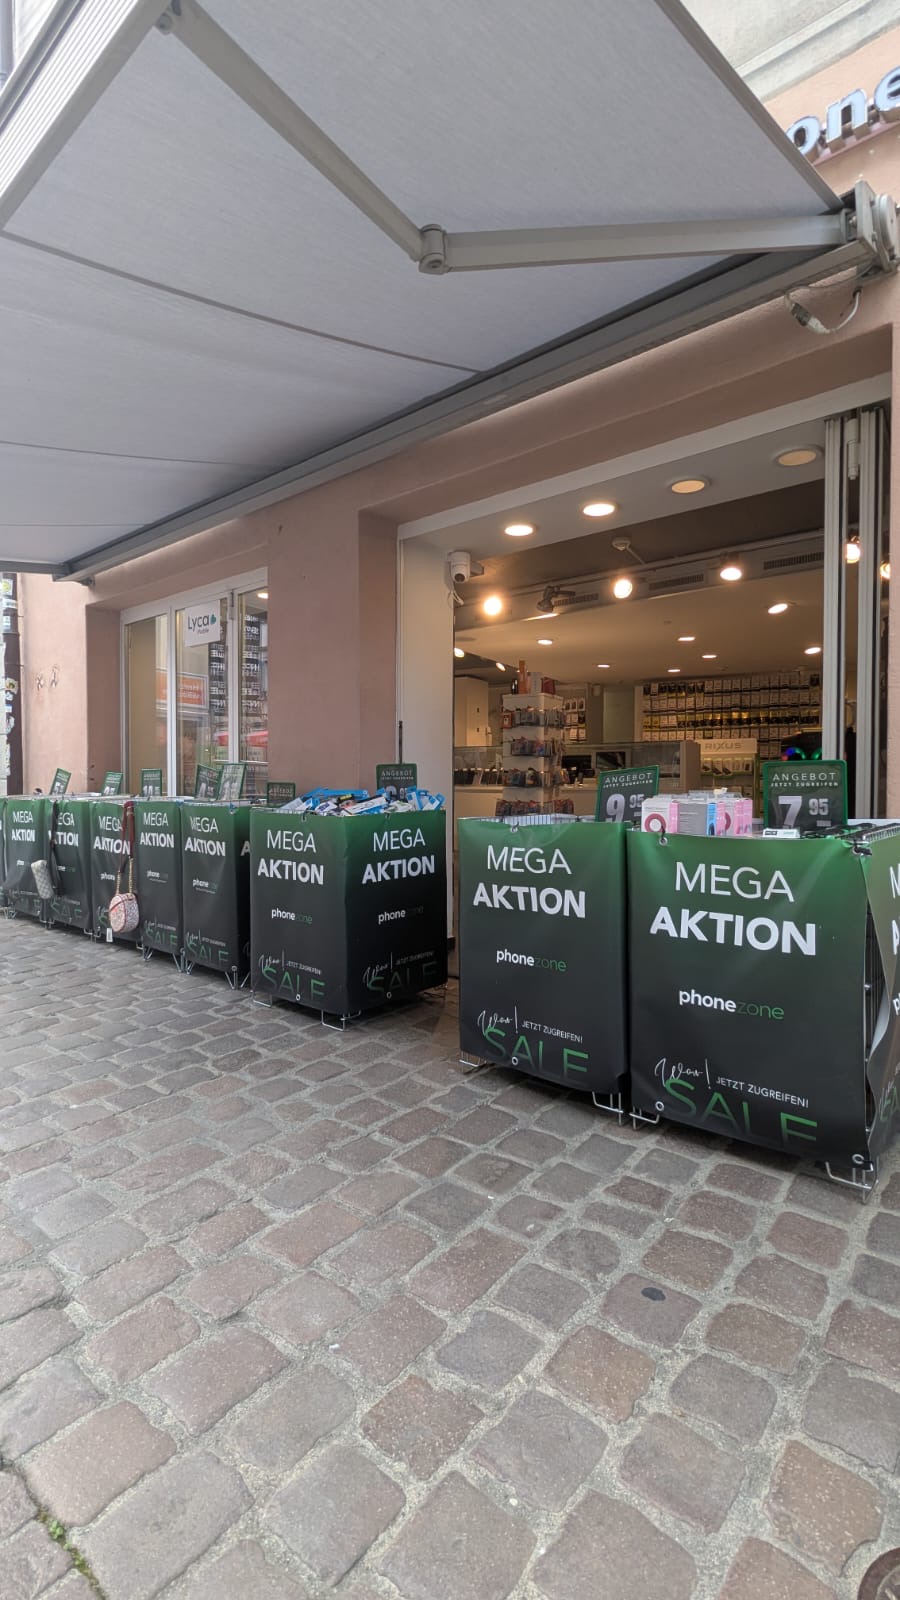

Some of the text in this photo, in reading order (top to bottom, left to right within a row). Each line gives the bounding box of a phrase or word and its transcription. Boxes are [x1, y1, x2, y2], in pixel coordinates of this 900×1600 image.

[188, 614, 210, 632] Lyca
[705, 741, 742, 752] RIXUS
[605, 772, 652, 784] ANGEBOT
[772, 772, 837, 781] ANGEBOT
[12, 811, 34, 823] MEGA
[57, 812, 75, 827] EGA
[143, 812, 169, 827] MEGA
[606, 793, 625, 823] 9
[778, 795, 829, 829] 7 95
[11, 828, 36, 842] AKTION
[93, 836, 131, 855] AKTION
[140, 832, 175, 849] AKTION
[184, 837, 226, 857] AKTION
[266, 829, 317, 853] MEGA
[373, 828, 426, 852] MEGA
[257, 858, 324, 885] AKTION
[361, 855, 435, 885] AKTION
[487, 845, 572, 875] MEGA
[674, 861, 795, 902] MEGA
[472, 882, 586, 918] AKTION
[650, 906, 816, 956] AKTION
[496, 949, 567, 972] phonezone
[678, 989, 785, 1020] phonezone
[521, 1020, 542, 1032] JETZT
[543, 1024, 584, 1044] ZUGREIFEN!
[715, 1076, 745, 1090] JETZT
[747, 1083, 810, 1108] ZUGREIFEN!
